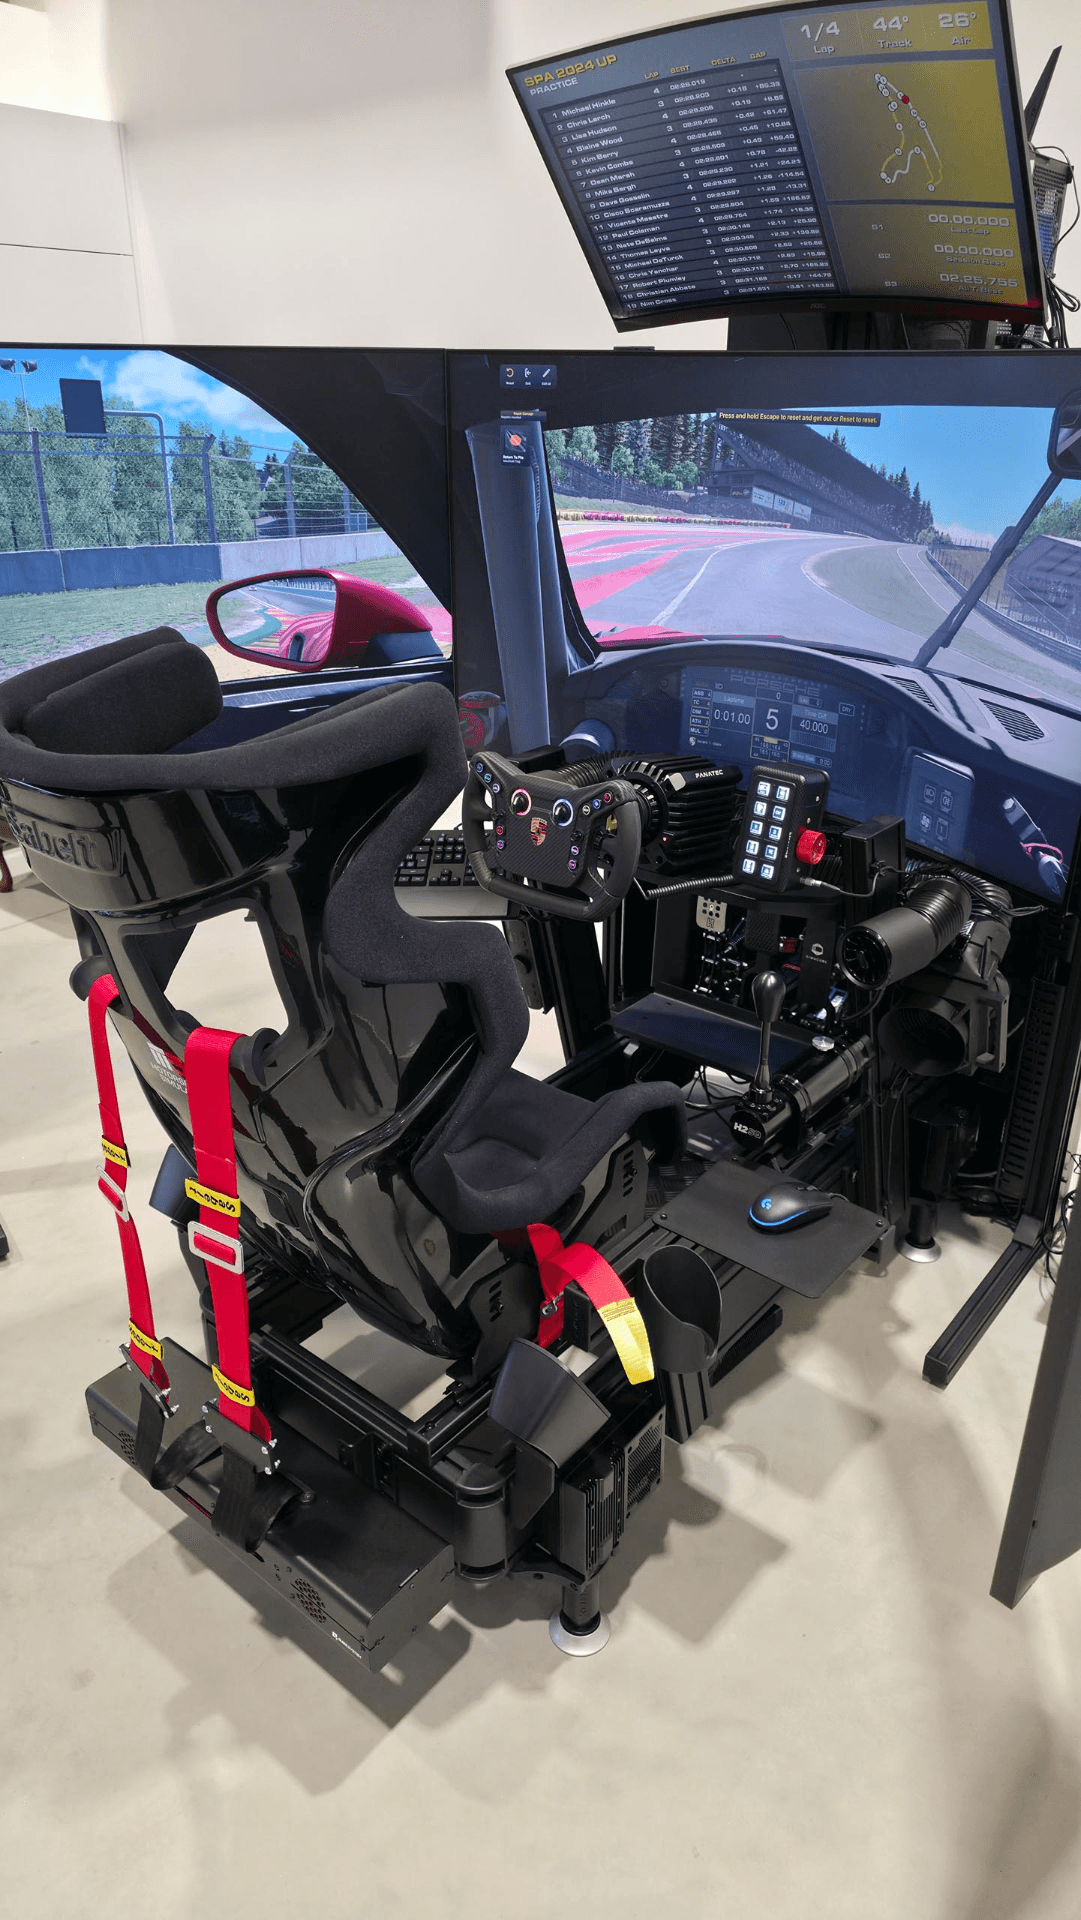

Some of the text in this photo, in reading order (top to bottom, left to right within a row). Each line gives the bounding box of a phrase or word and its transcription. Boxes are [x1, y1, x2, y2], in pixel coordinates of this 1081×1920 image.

[873, 16, 909, 32] 44°
[938, 12, 977, 29] 26°
[800, 21, 841, 42] 1/4
[877, 39, 913, 48] Track
[951, 36, 971, 45] Air
[813, 45, 835, 54] Lap
[710, 56, 736, 66] DELTA
[749, 51, 766, 59] GAP
[524, 54, 617, 87] SPA 2024 UP
[529, 77, 579, 96] PRACTICE
[561, 104, 591, 116] Michael
[566, 119, 587, 128] Chris
[570, 132, 587, 140] Lisa
[585, 166, 606, 174] Kevin
[589, 177, 610, 185] Dean
[598, 199, 618, 207] Dave
[607, 219, 636, 228] Vicente
[928, 214, 1010, 227] 00.00.000
[619, 250, 648, 258] Thomas
[934, 244, 1014, 258] 00.00.000
[624, 259, 652, 268] Michael
[632, 280, 657, 288] Robert
[939, 273, 1018, 288] 02.25.755
[636, 289, 669, 297] Christian
[759, 413, 780, 421] Escape
[730, 674, 820, 697] PORSCHE
[776, 692, 781, 700] 0
[714, 709, 751, 725] 0:01.00
[765, 708, 779, 730] 5
[799, 719, 829, 734] 40.000
[694, 769, 724, 779] FANATEC
